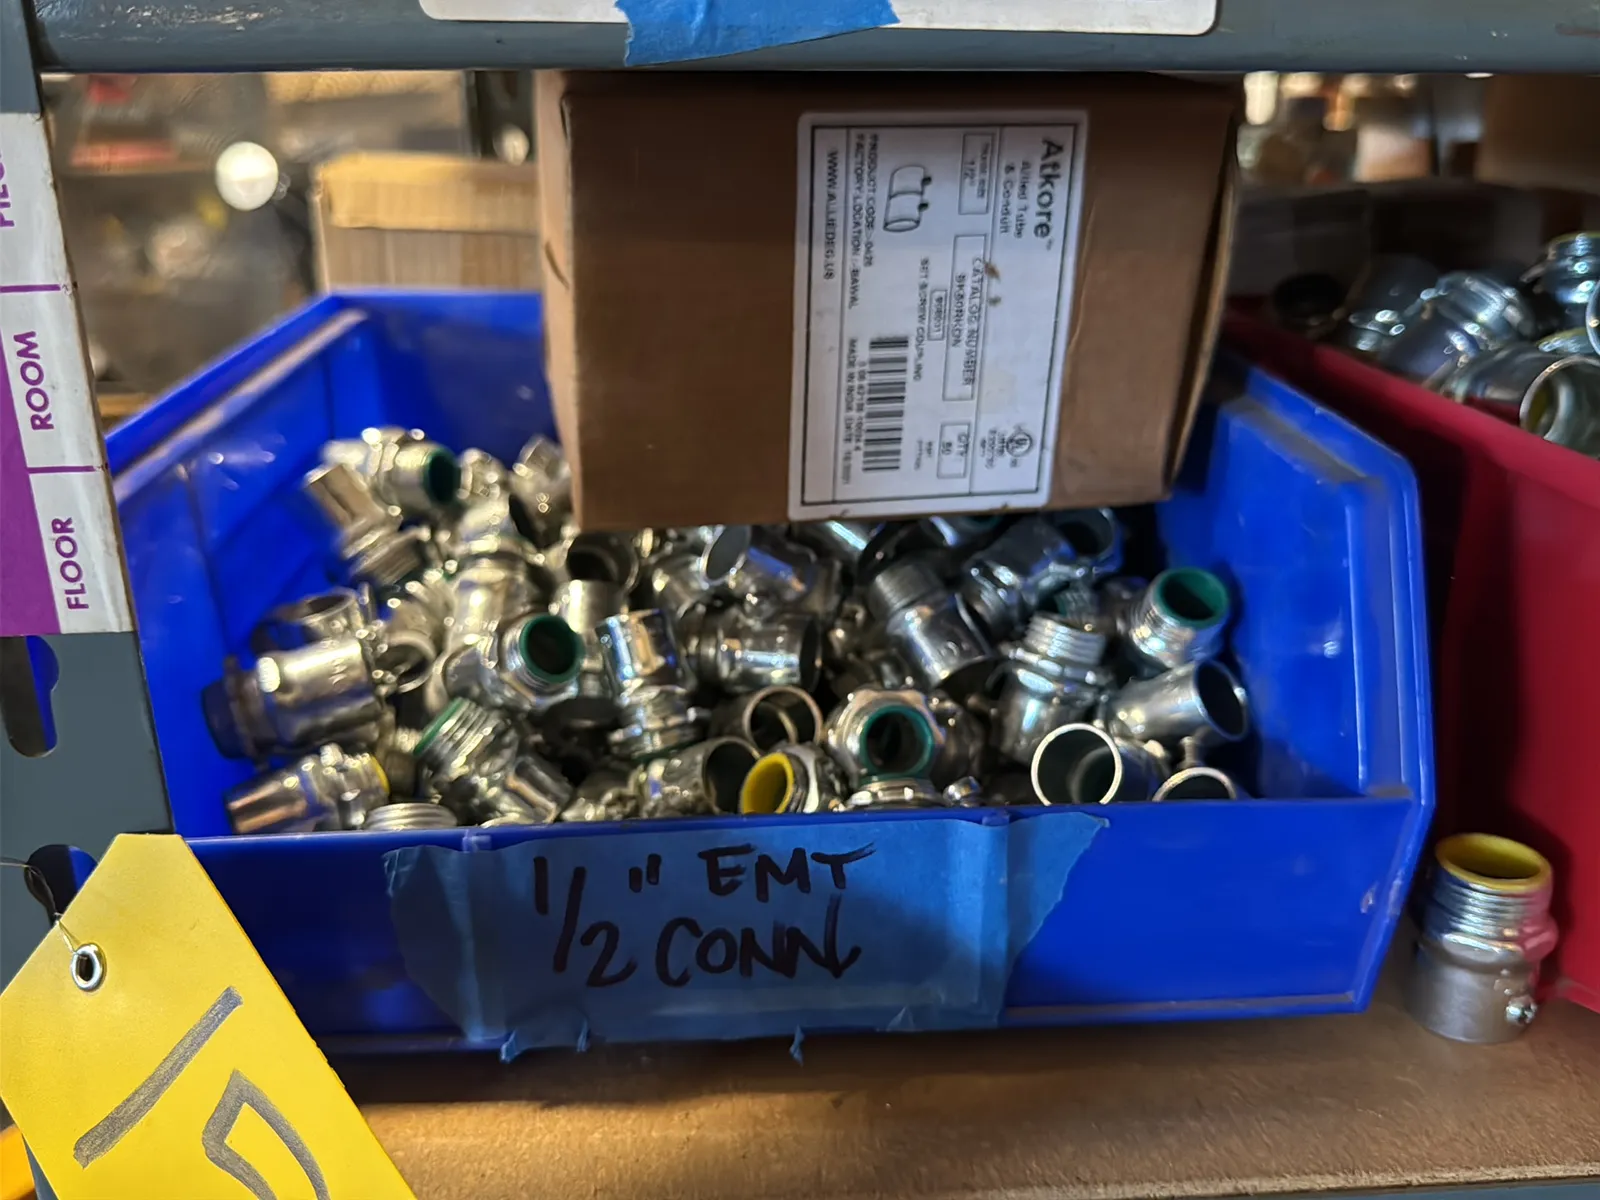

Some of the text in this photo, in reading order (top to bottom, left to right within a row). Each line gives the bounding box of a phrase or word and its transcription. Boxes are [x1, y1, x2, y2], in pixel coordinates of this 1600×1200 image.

[1033, 139, 1065, 239] Atkore
[14, 330, 54, 432] ROOM
[962, 328, 979, 387] NUMBER
[52, 516, 90, 611] FLOOR
[698, 842, 877, 903] EMT
[655, 893, 863, 988] CONN
